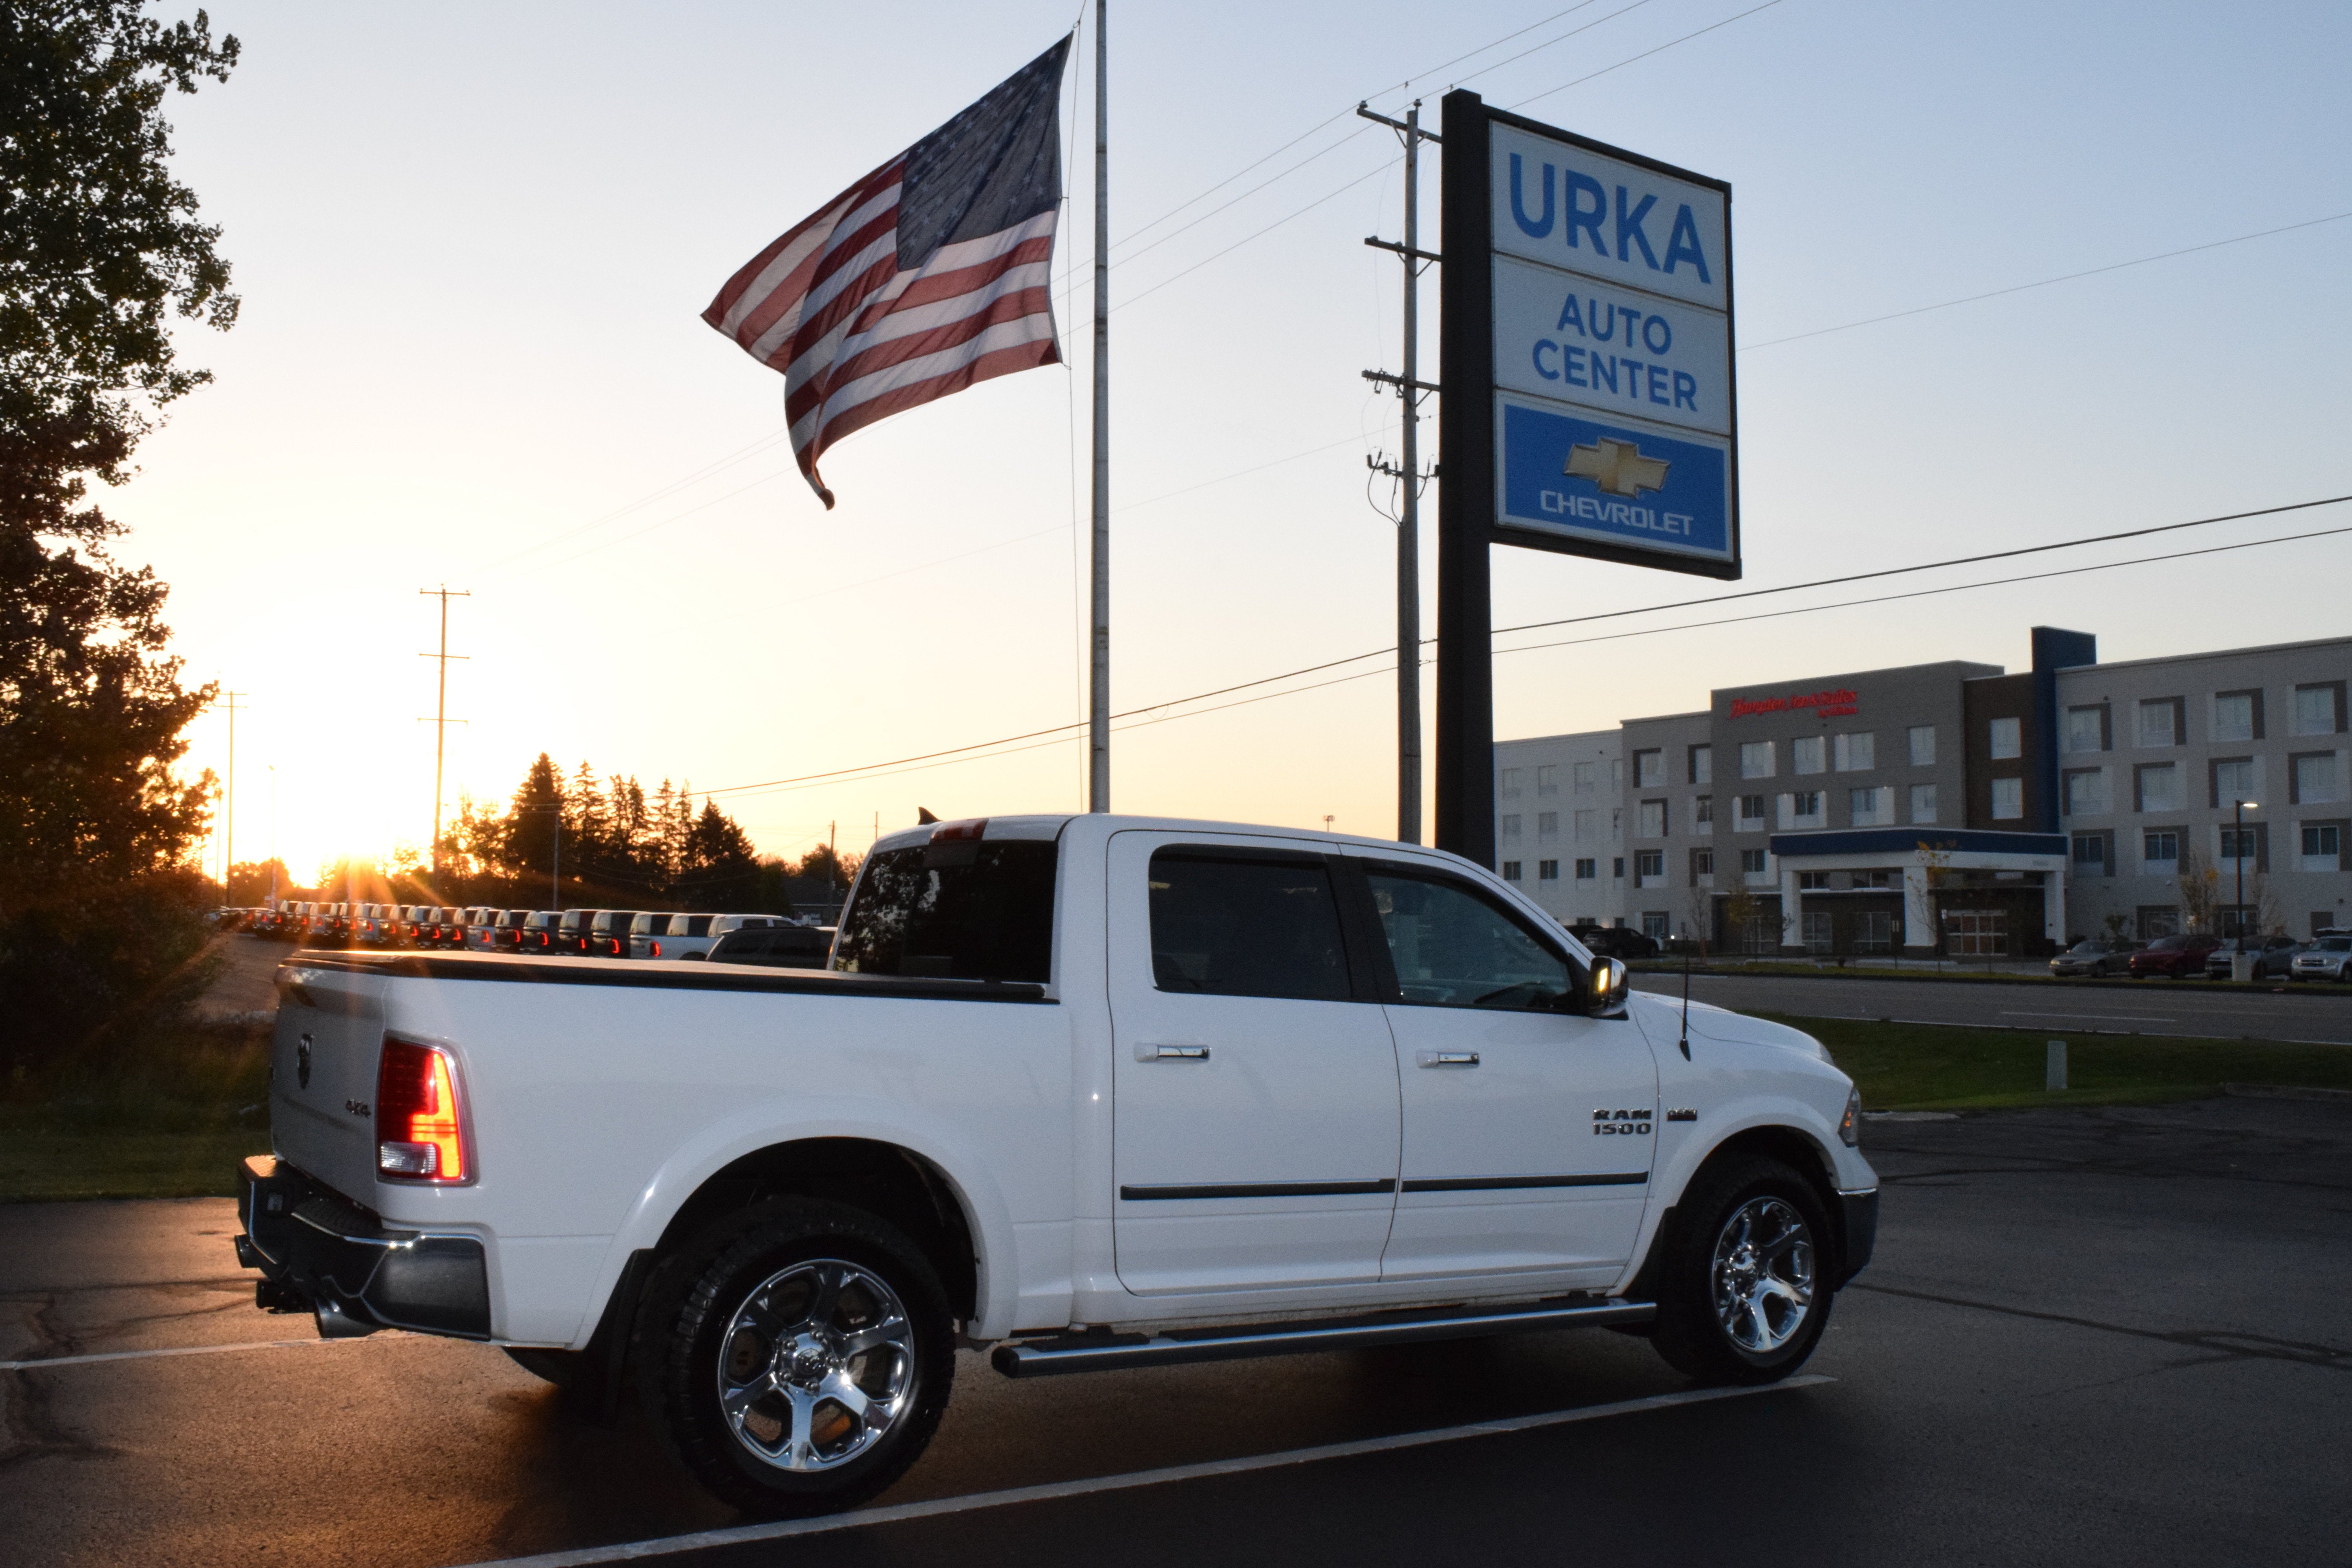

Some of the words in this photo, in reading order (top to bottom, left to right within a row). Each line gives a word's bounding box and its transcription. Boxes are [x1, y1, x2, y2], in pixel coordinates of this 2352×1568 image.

[1510, 152, 1711, 284] URKA
[1557, 293, 1672, 355] AUTO
[1532, 339, 1698, 412] CENTER
[1540, 490, 1693, 535] CHEVROLET
[1593, 1108, 1652, 1120] RAM
[1593, 1123, 1651, 1135] 1500
